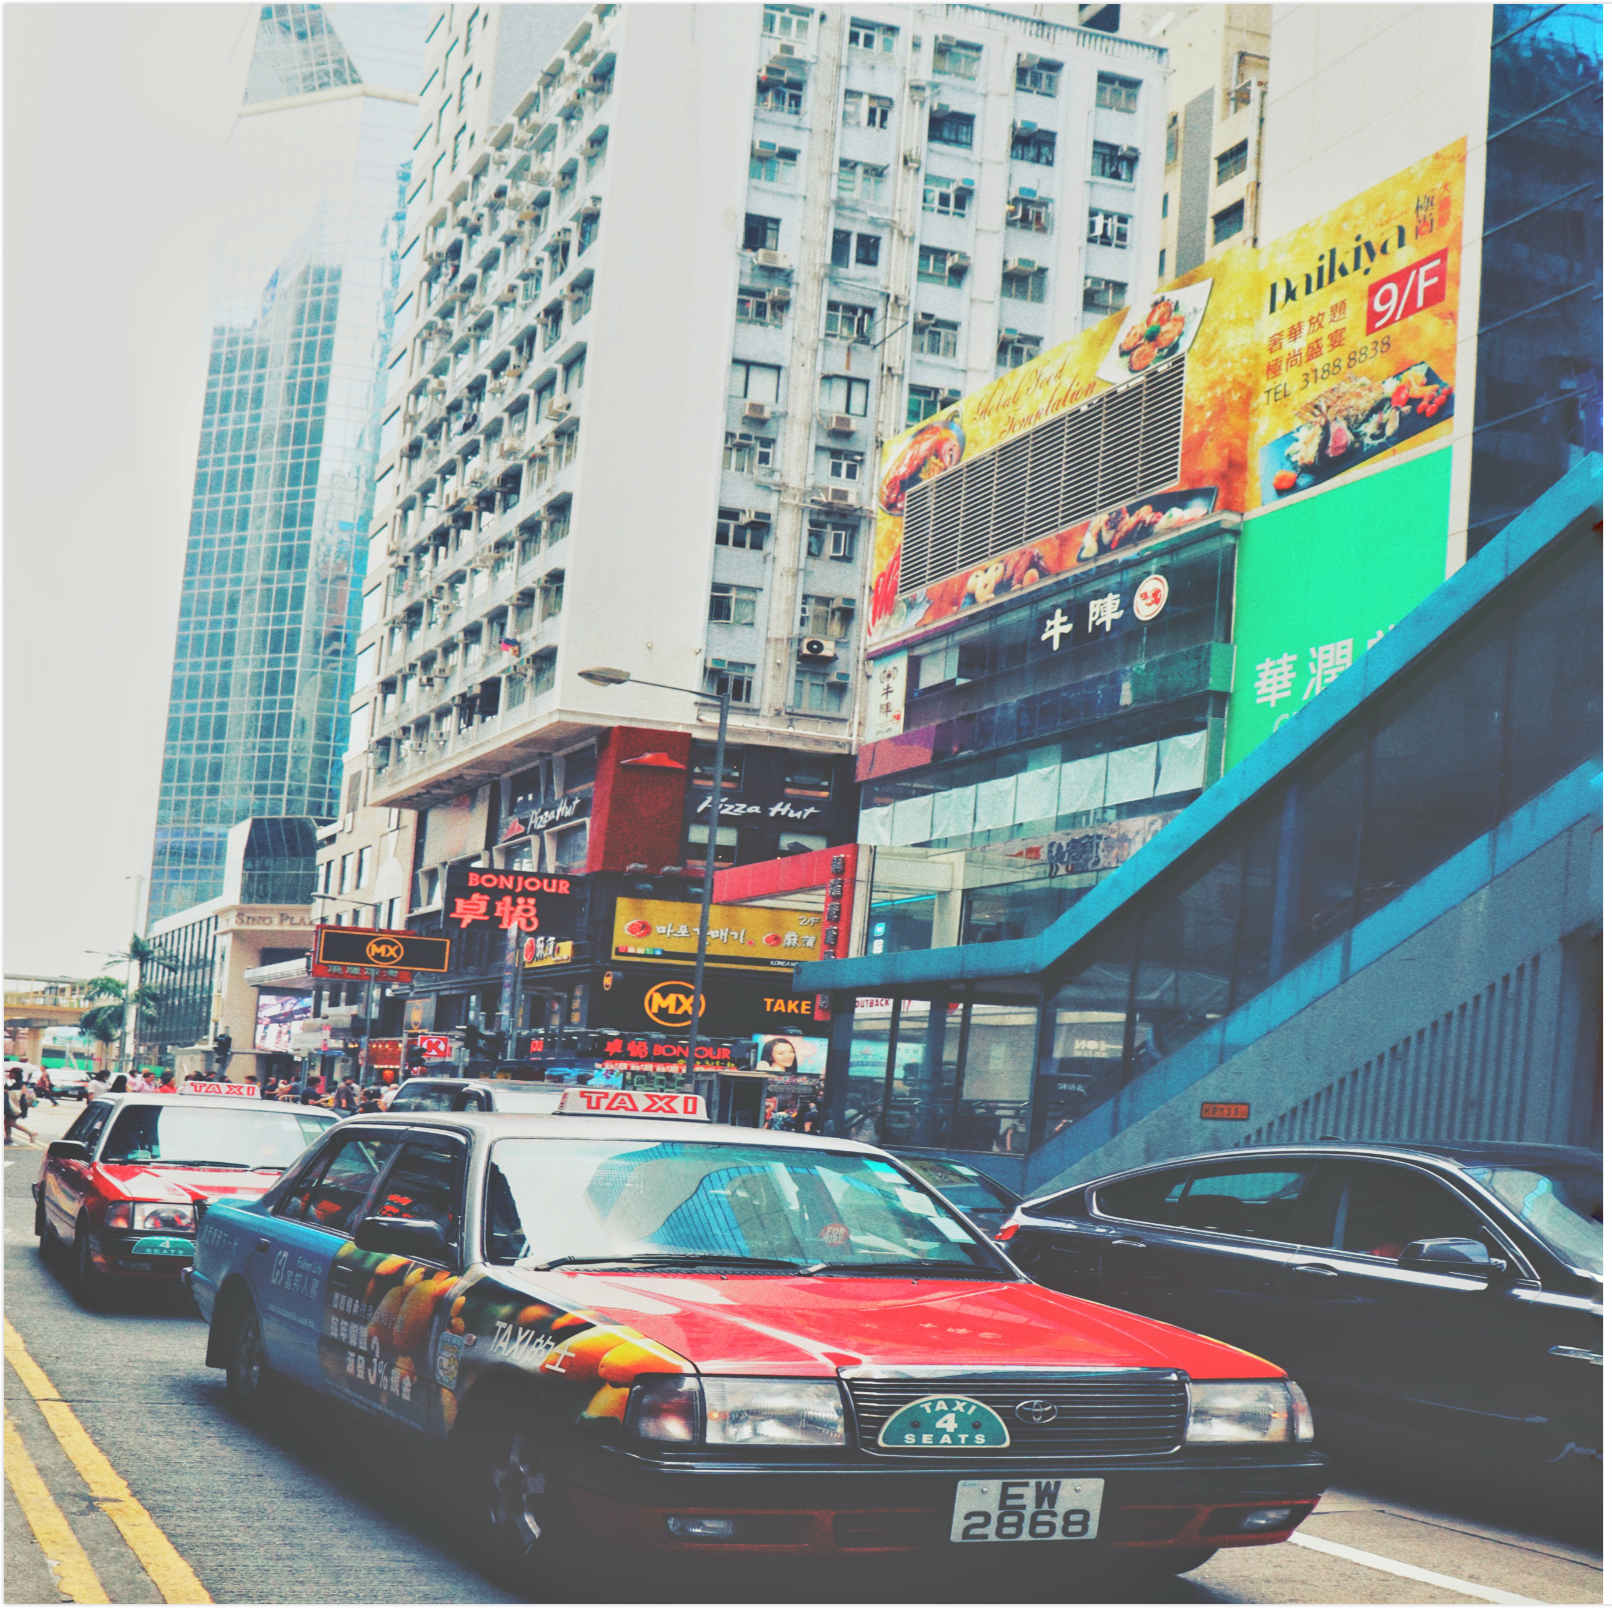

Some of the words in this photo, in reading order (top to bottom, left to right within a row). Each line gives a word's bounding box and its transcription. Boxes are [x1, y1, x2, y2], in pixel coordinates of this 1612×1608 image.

[1269, 224, 1406, 315] Daikiya
[1373, 258, 1442, 329] 9/F
[1264, 382, 1291, 405] TEL
[1300, 357, 1342, 391] 3188
[1347, 334, 1392, 369] 8838
[1254, 624, 1395, 708] 華潤
[527, 807, 556, 834] Pizza
[556, 798, 581, 821] Hut
[768, 801, 822, 820] Hut
[467, 872, 571, 895] BONJOUR
[371, 943, 398, 959] MX
[651, 991, 696, 1016] MX
[763, 997, 812, 1015] TAKE
[653, 1043, 731, 1060] BONOUR
[190, 1081, 257, 1097] TAXI
[579, 1089, 699, 1115] TAXI
[920, 1400, 977, 1415] TAXI
[935, 1412, 958, 1433] 4
[904, 1434, 986, 1445] SEATS
[998, 1480, 1061, 1511] EW
[961, 1508, 1091, 1541] 2868
